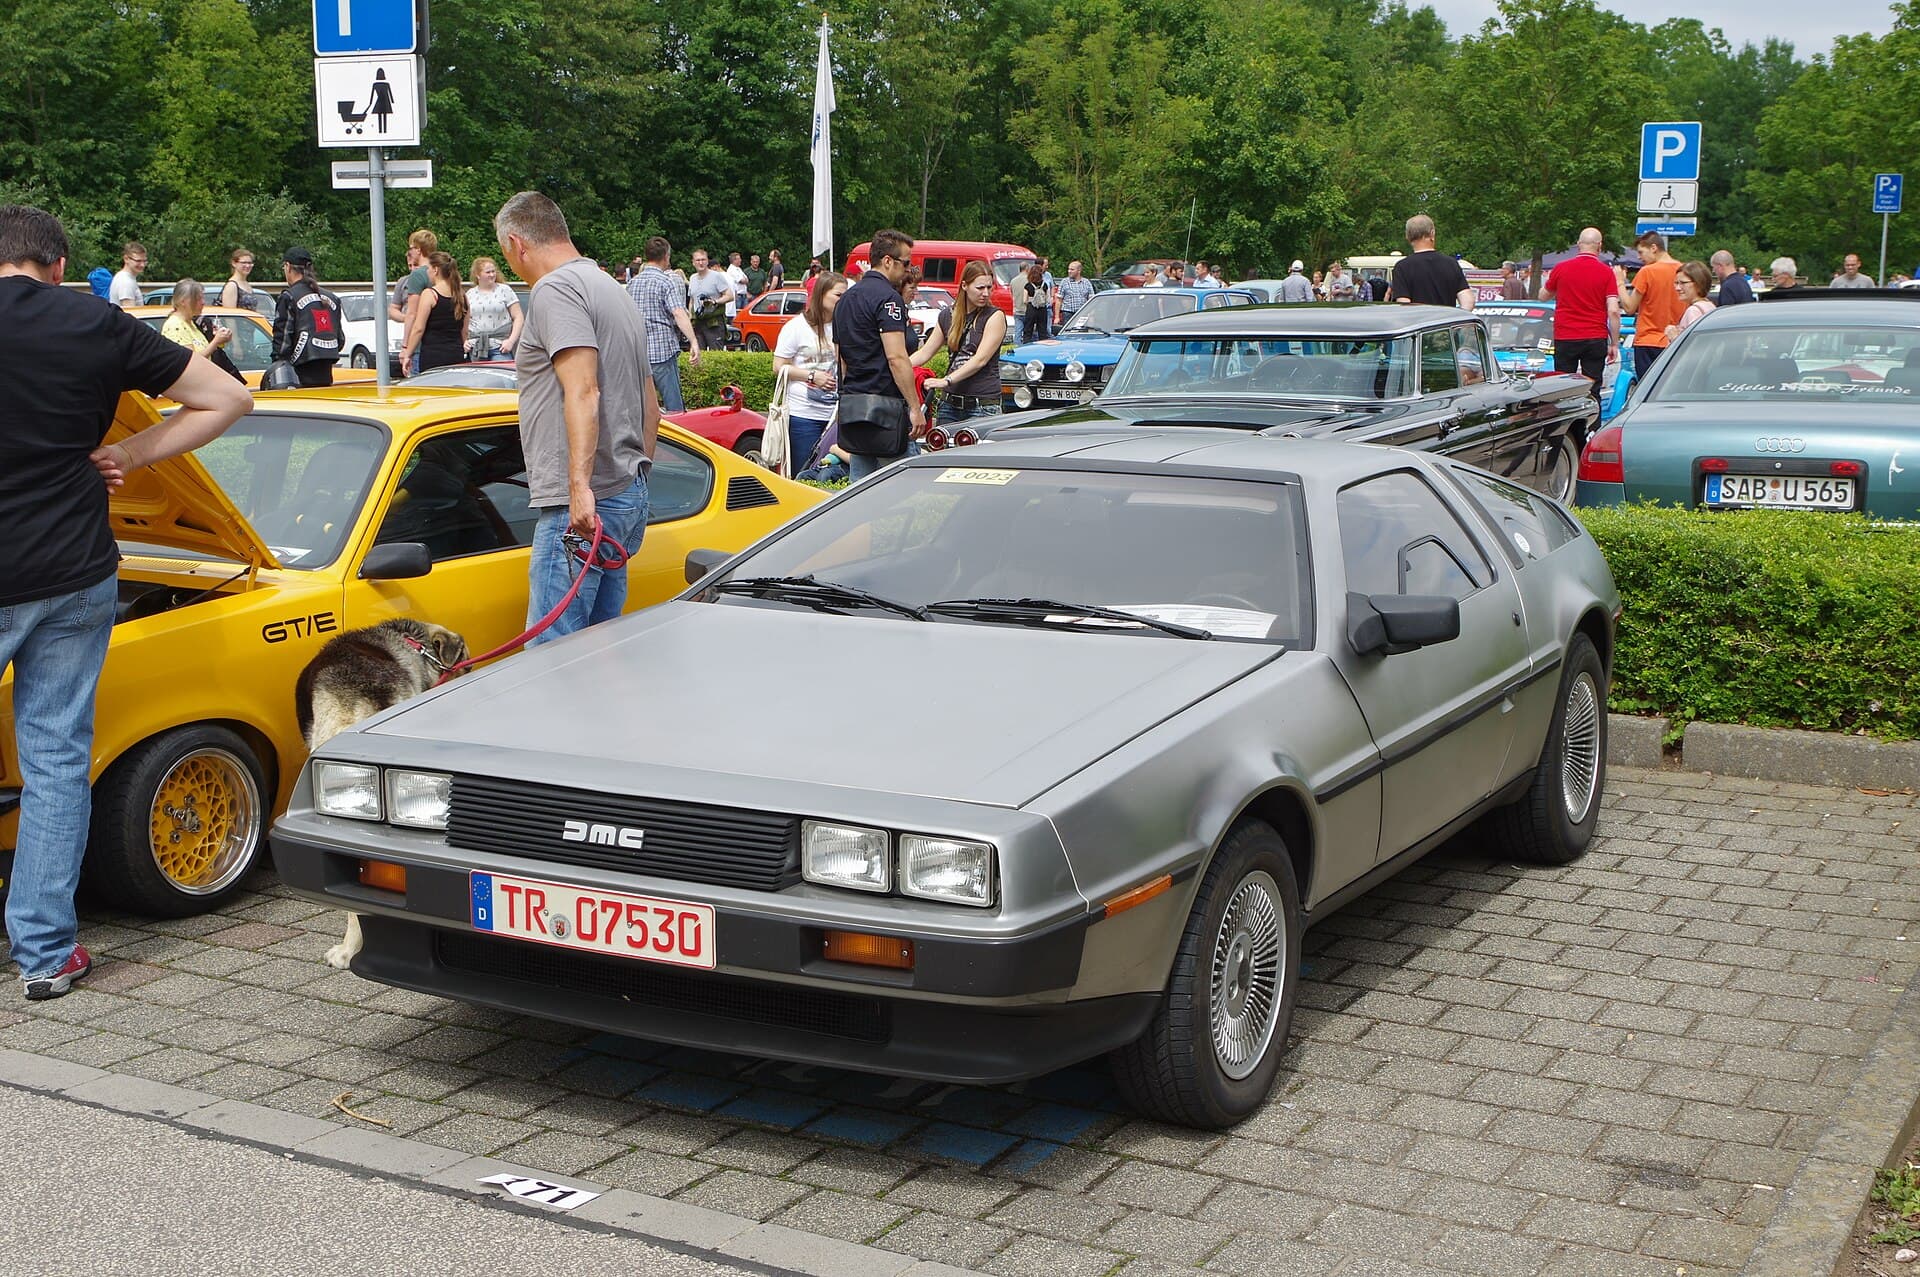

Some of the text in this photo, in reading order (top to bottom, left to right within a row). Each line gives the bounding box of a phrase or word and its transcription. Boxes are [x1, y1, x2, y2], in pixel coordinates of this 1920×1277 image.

[1654, 130, 1687, 173] P
[1879, 176, 1892, 191] P
[884, 301, 902, 321] 75
[963, 471, 1013, 481] 0023
[1721, 478, 1766, 500] SAB
[1783, 480, 1798, 501] U
[1804, 481, 1849, 503] 565
[478, 884, 702, 957] D TR 07530
